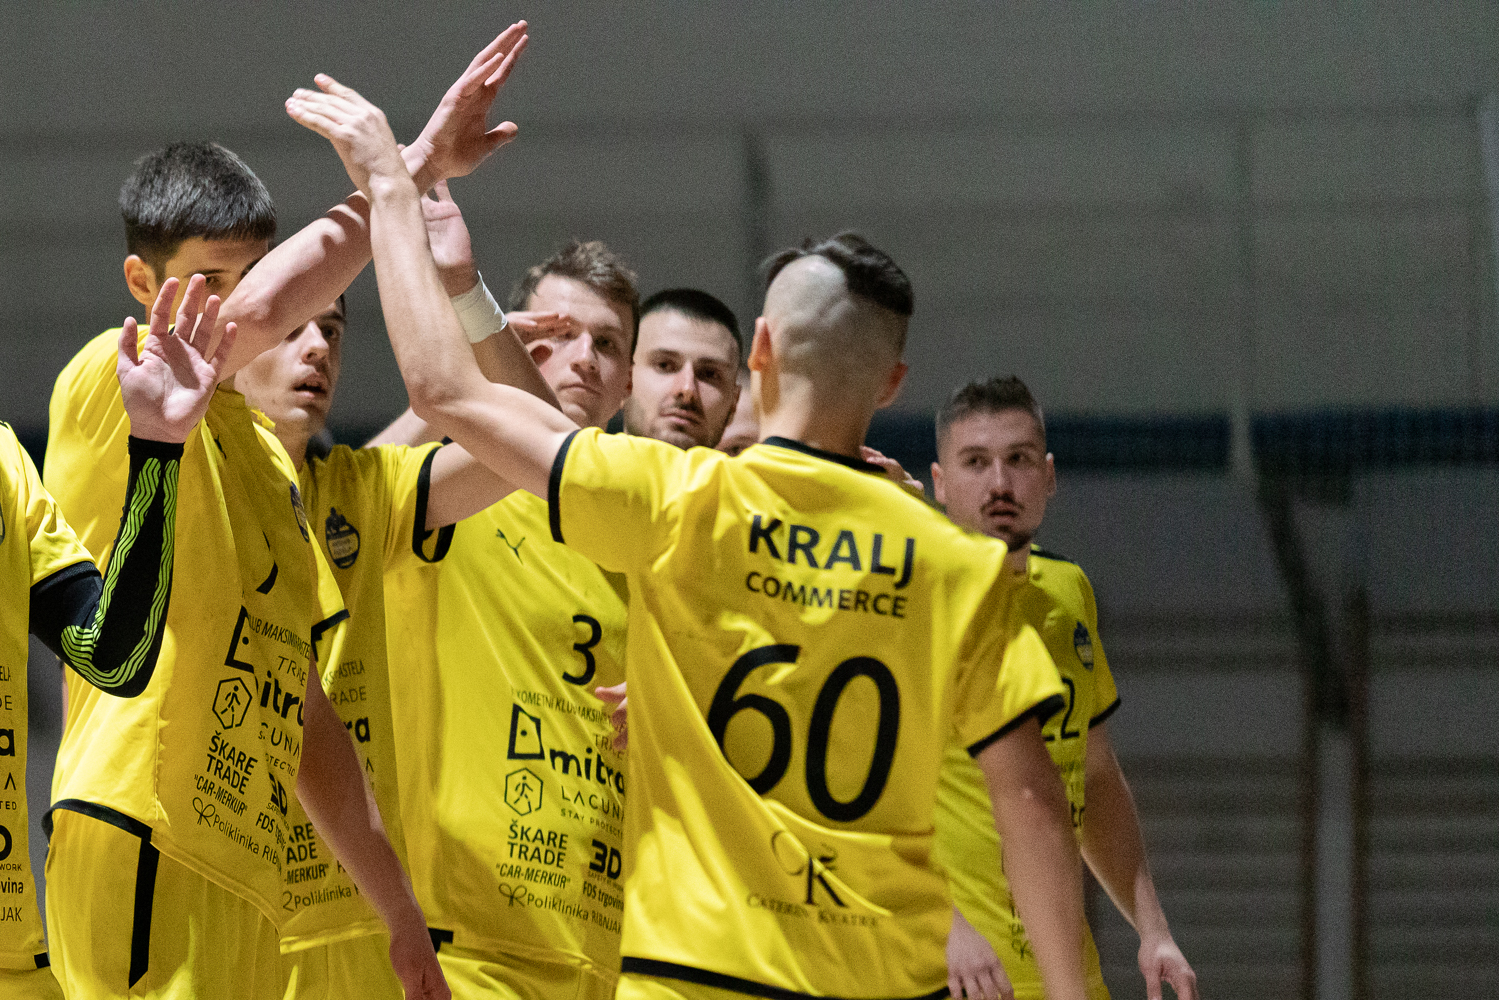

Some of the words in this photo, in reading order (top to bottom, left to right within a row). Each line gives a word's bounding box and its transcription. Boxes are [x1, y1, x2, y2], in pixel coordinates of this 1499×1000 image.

[748, 514, 916, 590] KRALJ
[746, 570, 908, 619] COMMERCE
[561, 613, 602, 687] 3
[257, 670, 304, 727] itr
[330, 685, 367, 706] RADE
[707, 643, 901, 823] 60
[209, 730, 258, 775] ŠKARE
[207, 753, 249, 795] TRADE
[212, 814, 260, 855] Poliklinika
[255, 812, 276, 834] FDS
[508, 818, 569, 851] ŠKARE
[589, 815, 622, 838] PROTECT
[286, 841, 318, 865] ADE
[507, 840, 567, 870] TRADE
[589, 838, 622, 880] 3D
[284, 863, 329, 886] -MERKUR"
[582, 880, 597, 900] FDS
[527, 892, 589, 921] Poliklinika
